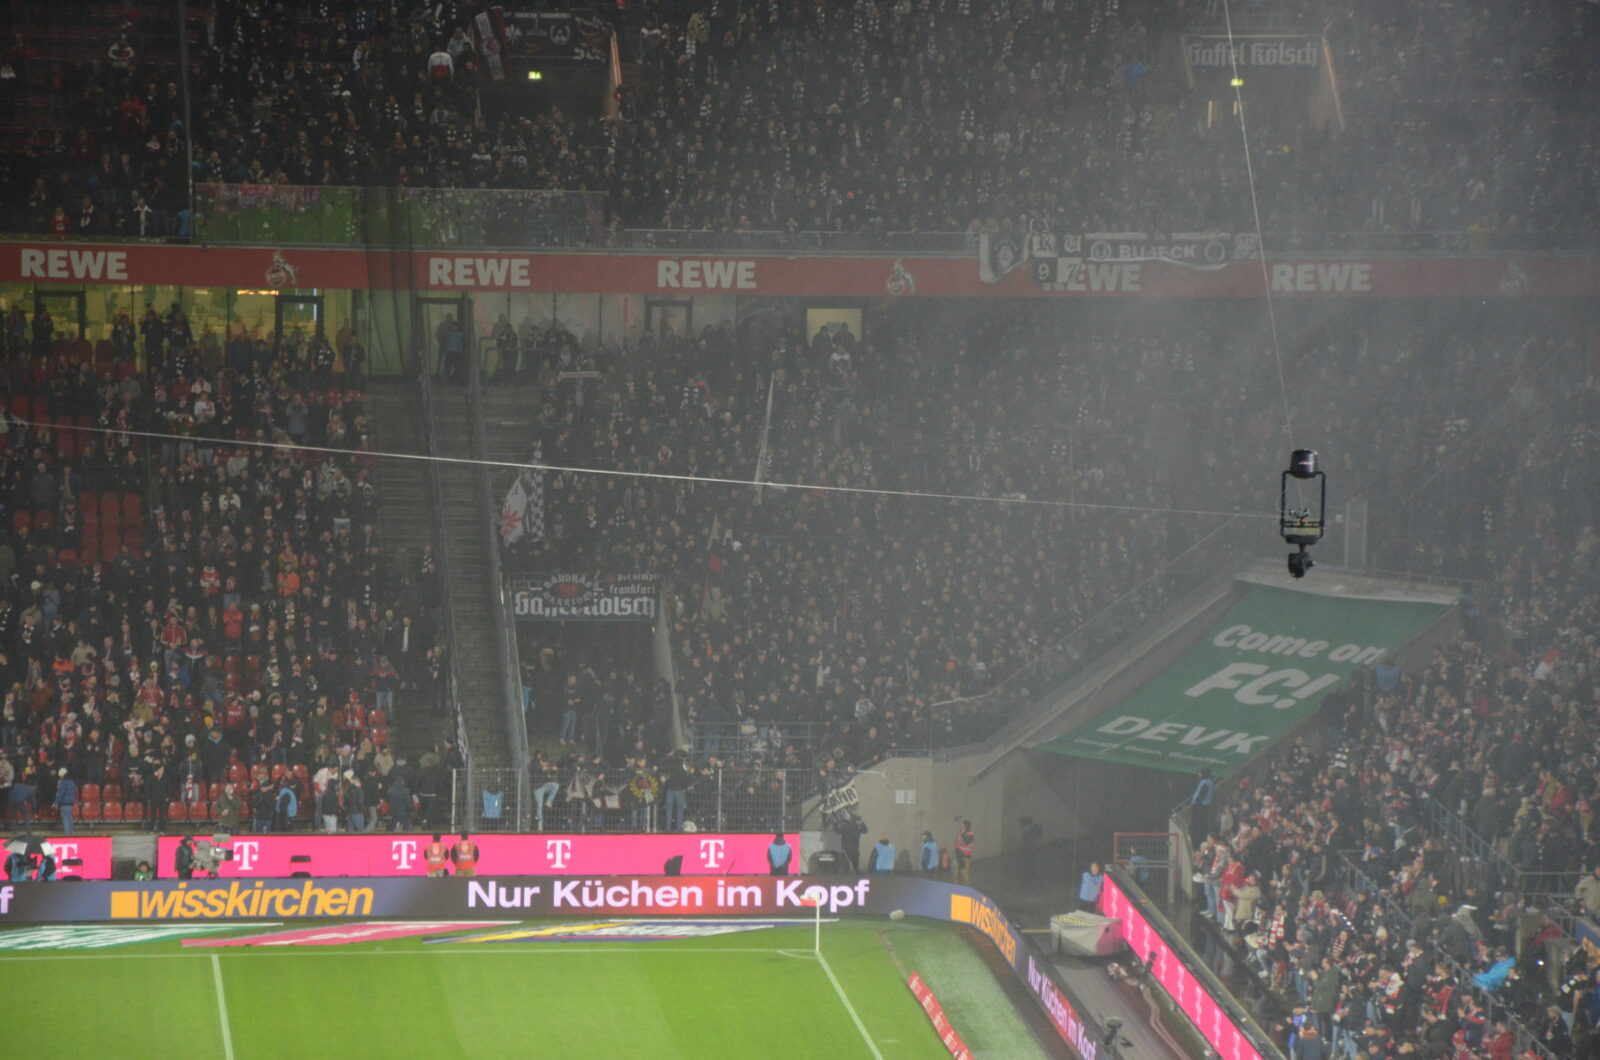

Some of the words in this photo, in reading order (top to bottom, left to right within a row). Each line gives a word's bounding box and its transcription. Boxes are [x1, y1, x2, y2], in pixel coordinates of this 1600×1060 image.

[1250, 41, 1319, 67] Kölsch
[20, 248, 129, 281] REWE
[428, 256, 531, 287] REWE
[656, 259, 757, 289] REWE
[1271, 262, 1372, 292] REWE
[1212, 624, 1330, 658] Come
[1327, 643, 1388, 665] on
[1183, 661, 1342, 709] FC!
[1095, 714, 1270, 754] DEVK
[233, 841, 259, 871] T
[391, 840, 417, 870] T
[546, 839, 571, 869] T
[700, 839, 725, 868] T
[141, 880, 375, 919] wisskirchen
[467, 880, 541, 909] Nur
[552, 879, 704, 908] Küchen
[716, 879, 763, 907] im
[775, 879, 871, 913] Kopf
